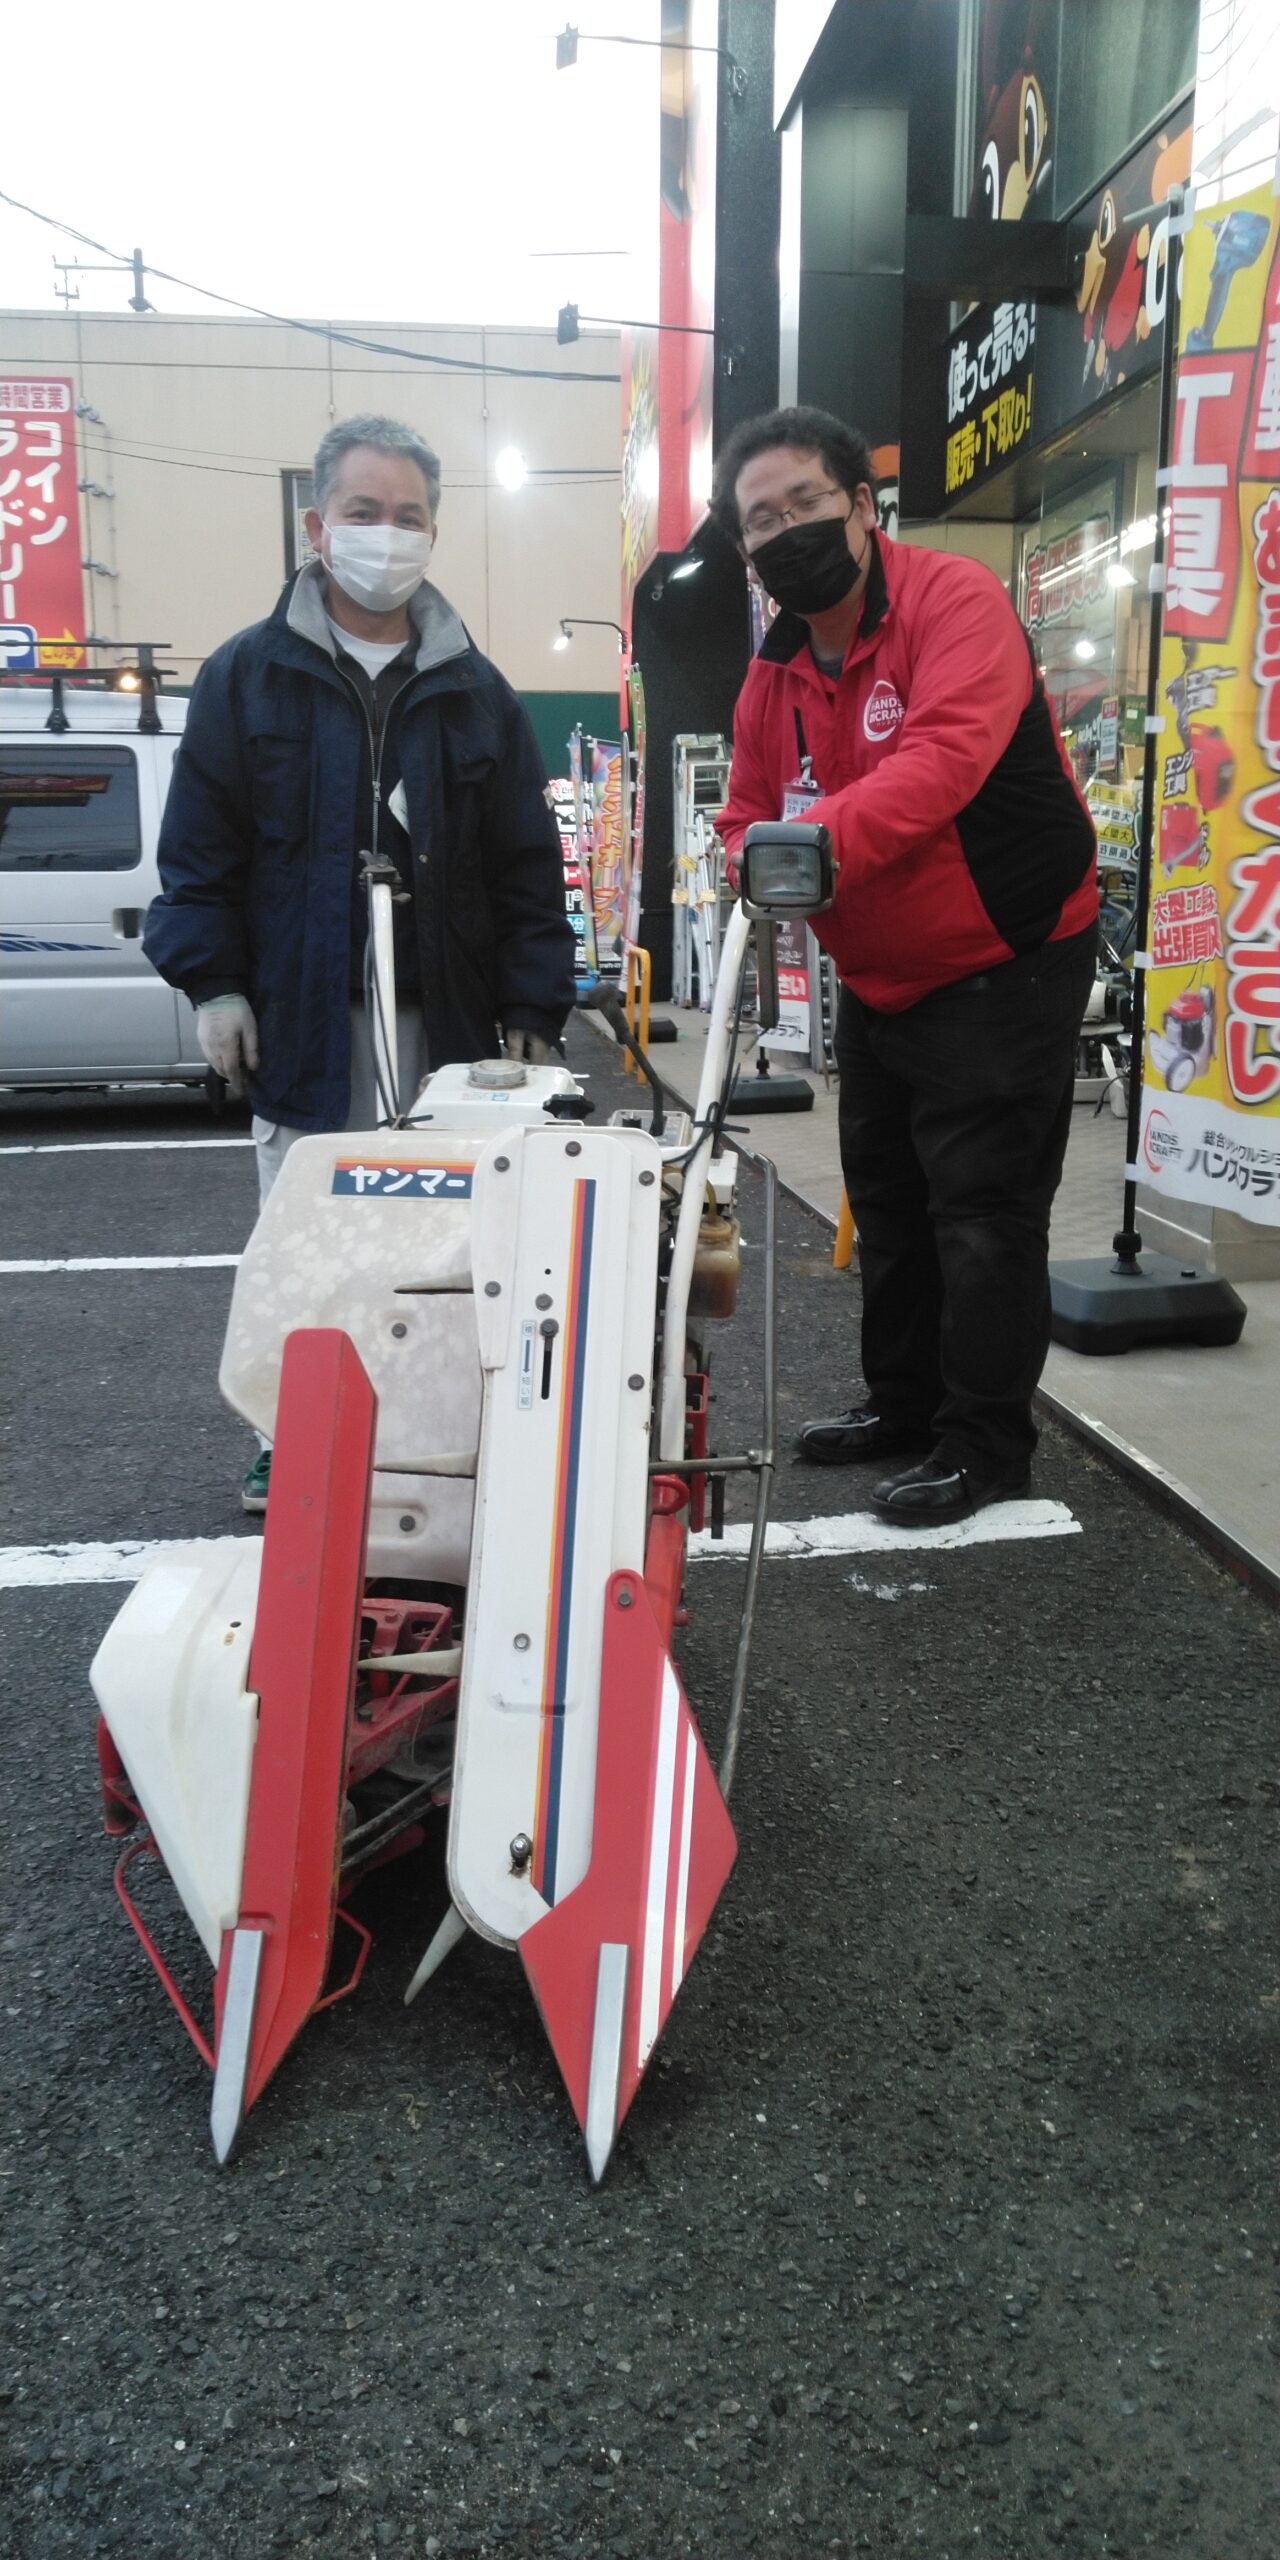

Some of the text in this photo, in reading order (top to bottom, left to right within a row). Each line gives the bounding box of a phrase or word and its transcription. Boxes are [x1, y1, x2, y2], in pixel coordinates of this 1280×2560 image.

[25, 421, 68, 546] コイン
[945, 373, 1033, 495] 販売・下取り!
[1166, 371, 1234, 617] 工具
[348, 1165, 466, 1195] ヤンマー
